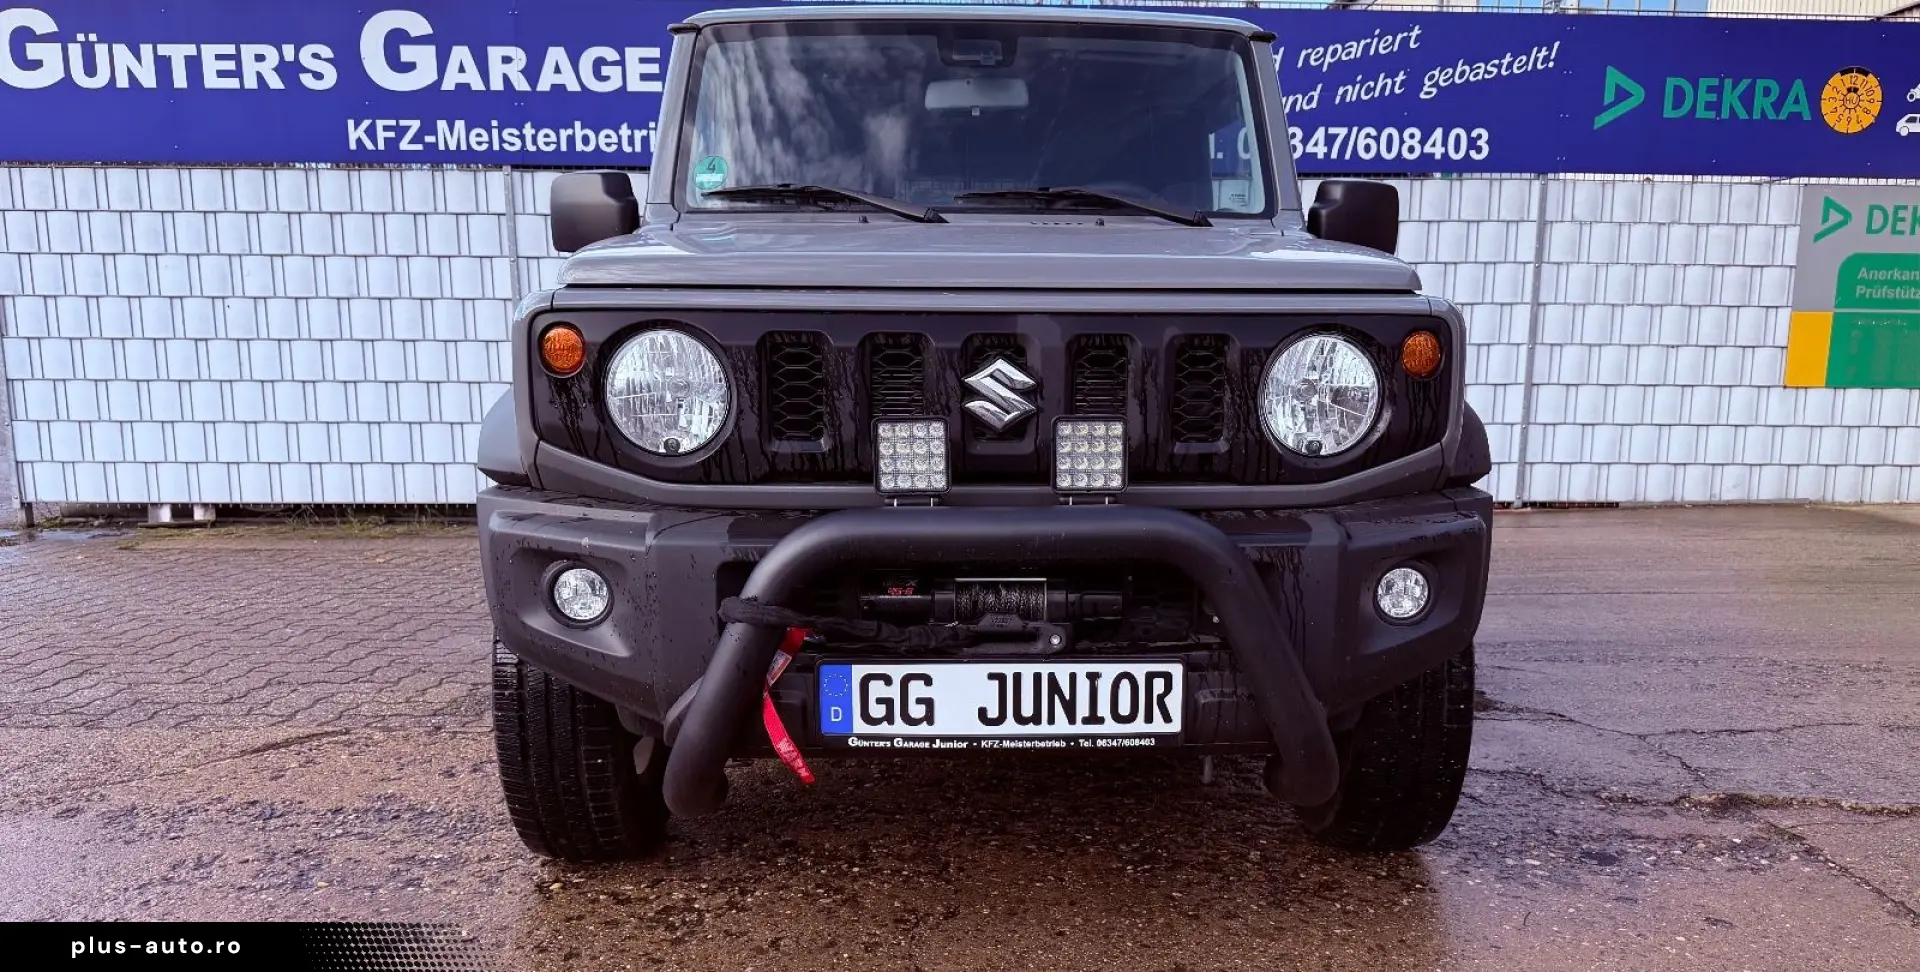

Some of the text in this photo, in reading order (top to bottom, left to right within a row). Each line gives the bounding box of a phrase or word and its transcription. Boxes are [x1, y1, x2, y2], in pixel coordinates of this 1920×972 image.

[0, 8, 663, 91] GÜNTER'S GARAGE
[1297, 24, 1421, 72] repariert
[1335, 69, 1406, 104] nicht
[1420, 40, 1560, 99] gebastelt!
[1662, 76, 1812, 121] DEKRA
[348, 119, 658, 152] KFZ-Meisterbetri
[706, 157, 716, 174] 4
[830, 706, 842, 722] D
[859, 670, 1175, 727] GG JUNIOR
[894, 738, 930, 749] GARAGE
[932, 739, 968, 749] Junior
[981, 738, 1067, 749] KFZ-Meisterbetrieb
[1079, 739, 1094, 748] Tel.
[1096, 738, 1156, 747] 06347/608403
